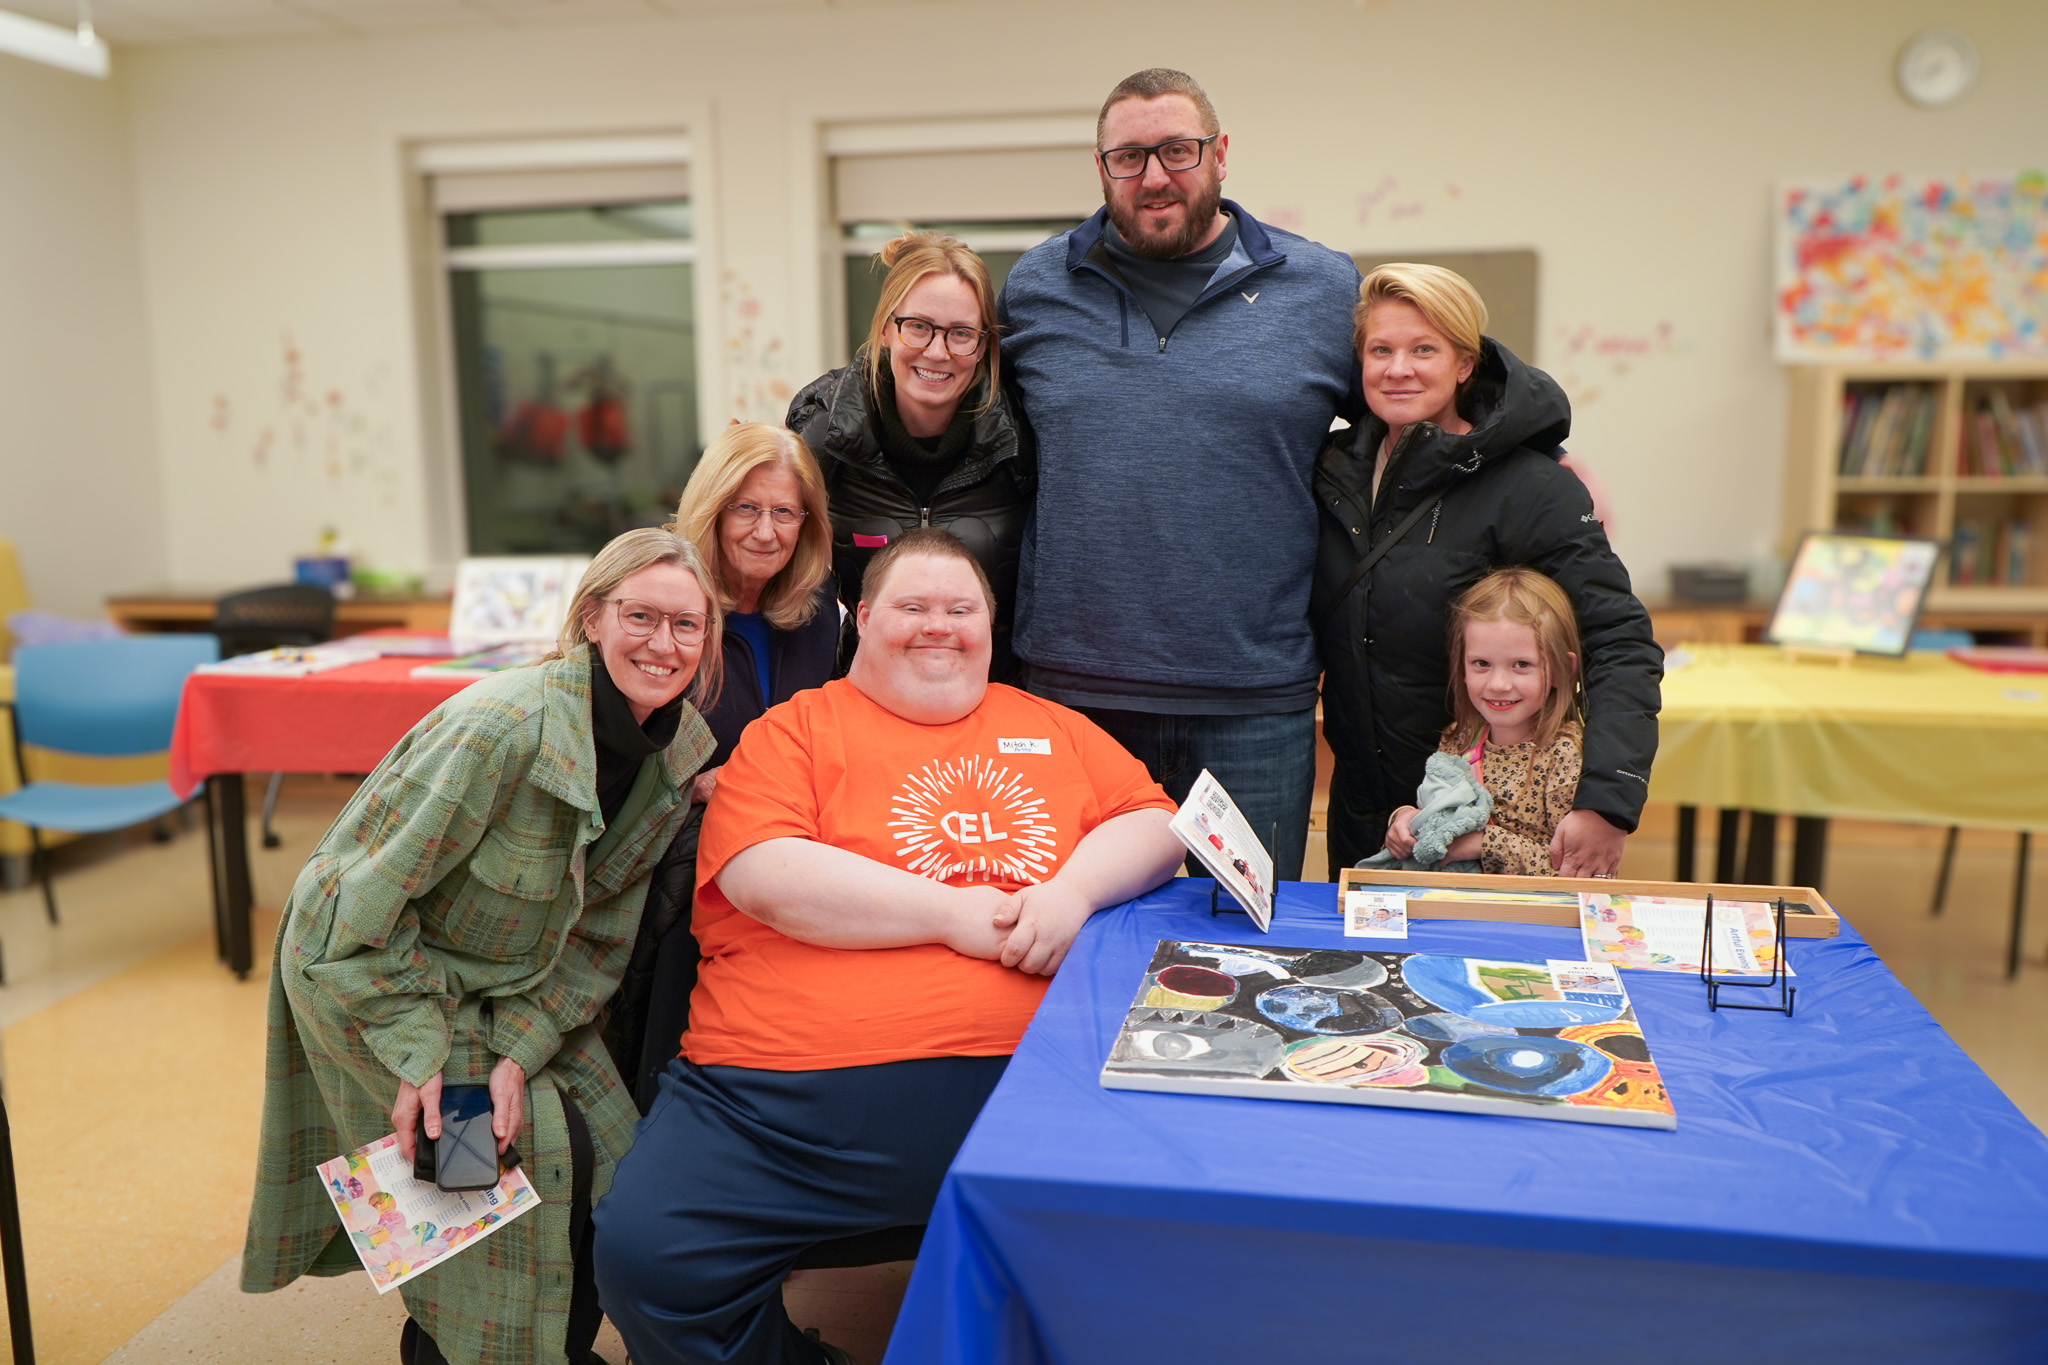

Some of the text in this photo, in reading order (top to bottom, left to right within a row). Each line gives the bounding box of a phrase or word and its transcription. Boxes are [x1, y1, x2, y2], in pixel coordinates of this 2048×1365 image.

[1003, 740, 1026, 749] Mitch
[940, 810, 1008, 844] CEL
[1729, 927, 1741, 946] Artful
[1734, 947, 1750, 970] Evening
